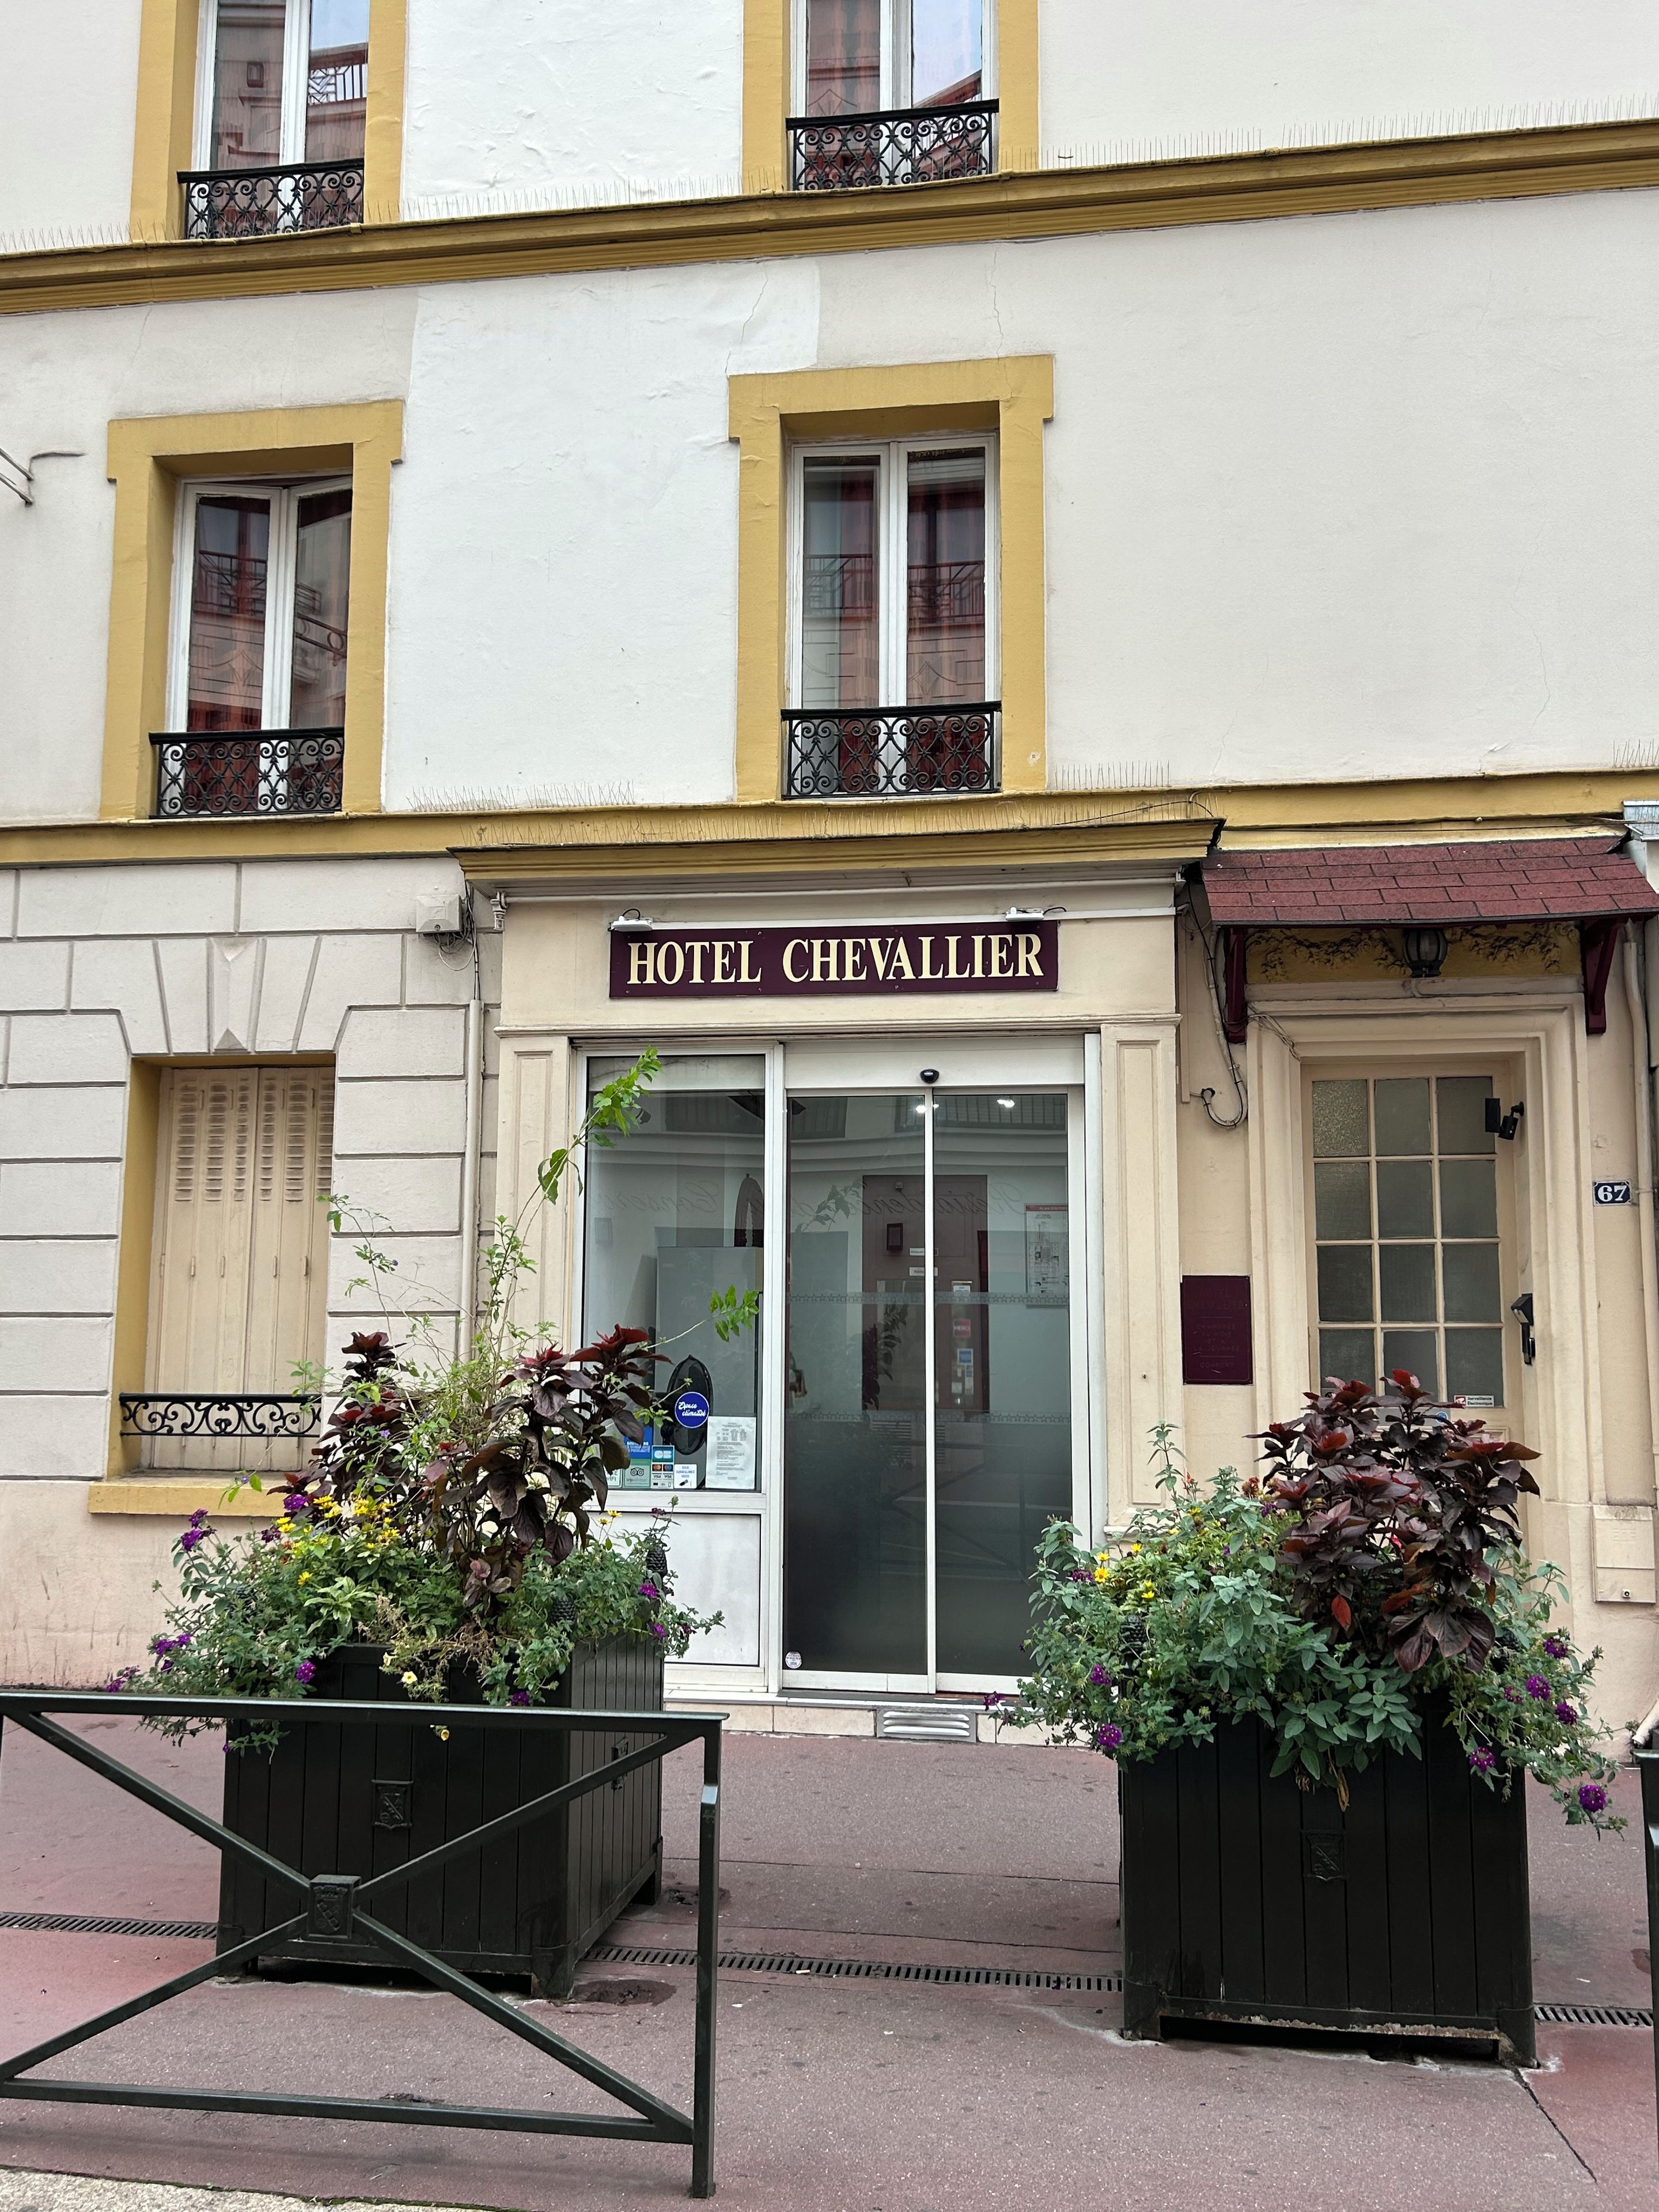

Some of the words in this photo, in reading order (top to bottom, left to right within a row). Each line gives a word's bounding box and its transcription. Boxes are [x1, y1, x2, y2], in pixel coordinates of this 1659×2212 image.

[627, 940, 762, 985] HOTEL
[782, 934, 1044, 983] CHEVALLIER
[1598, 1185, 1627, 1202] 67
